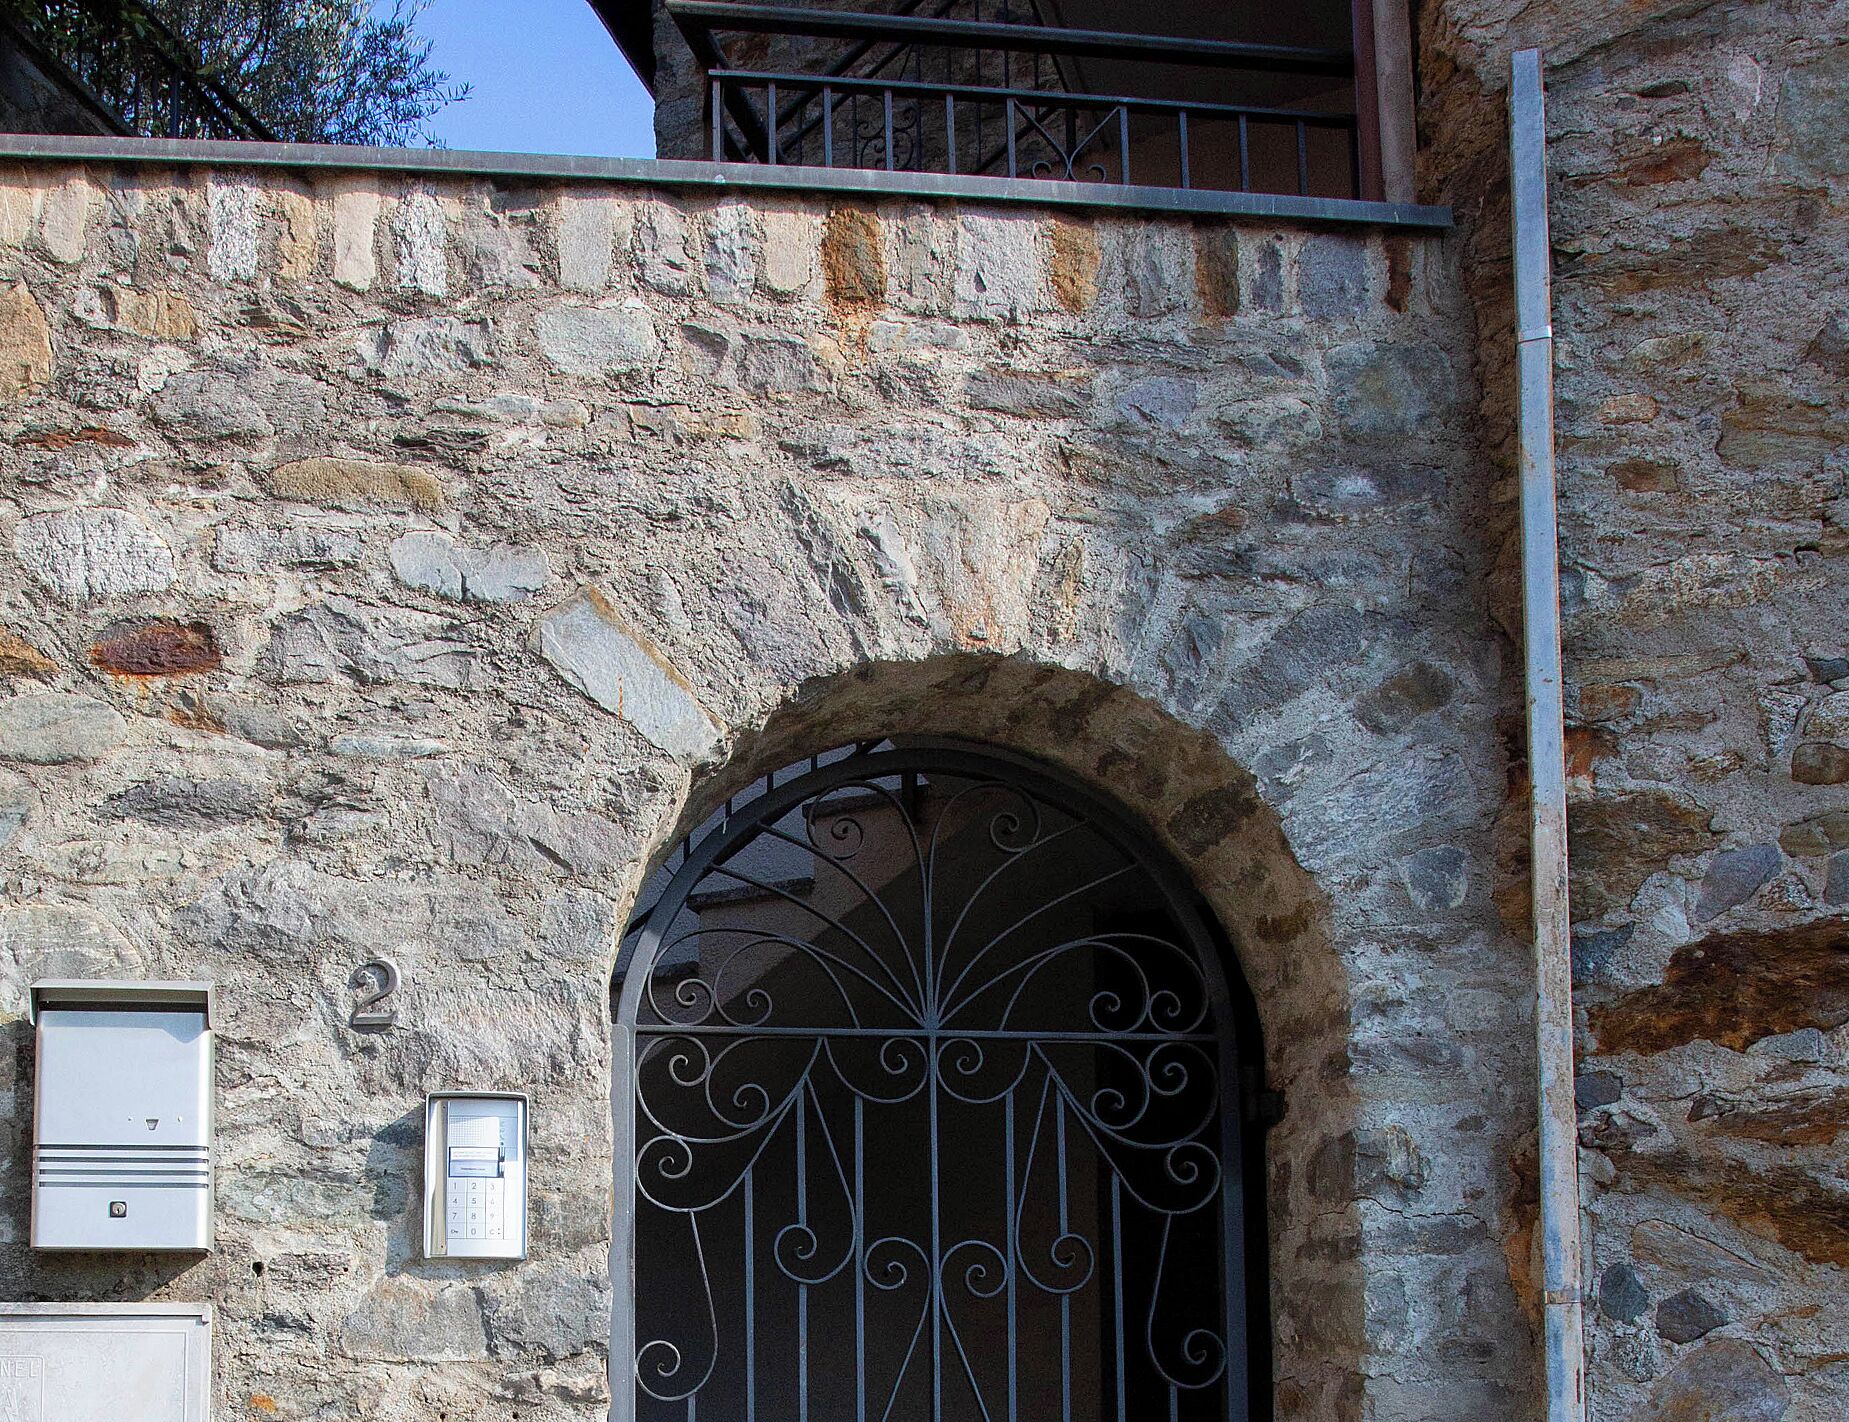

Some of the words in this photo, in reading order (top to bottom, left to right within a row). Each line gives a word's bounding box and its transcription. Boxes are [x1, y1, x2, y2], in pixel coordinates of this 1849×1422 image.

[347, 958, 398, 1027] 2
[471, 1182, 477, 1190] 2
[471, 1212, 477, 1220] 8
